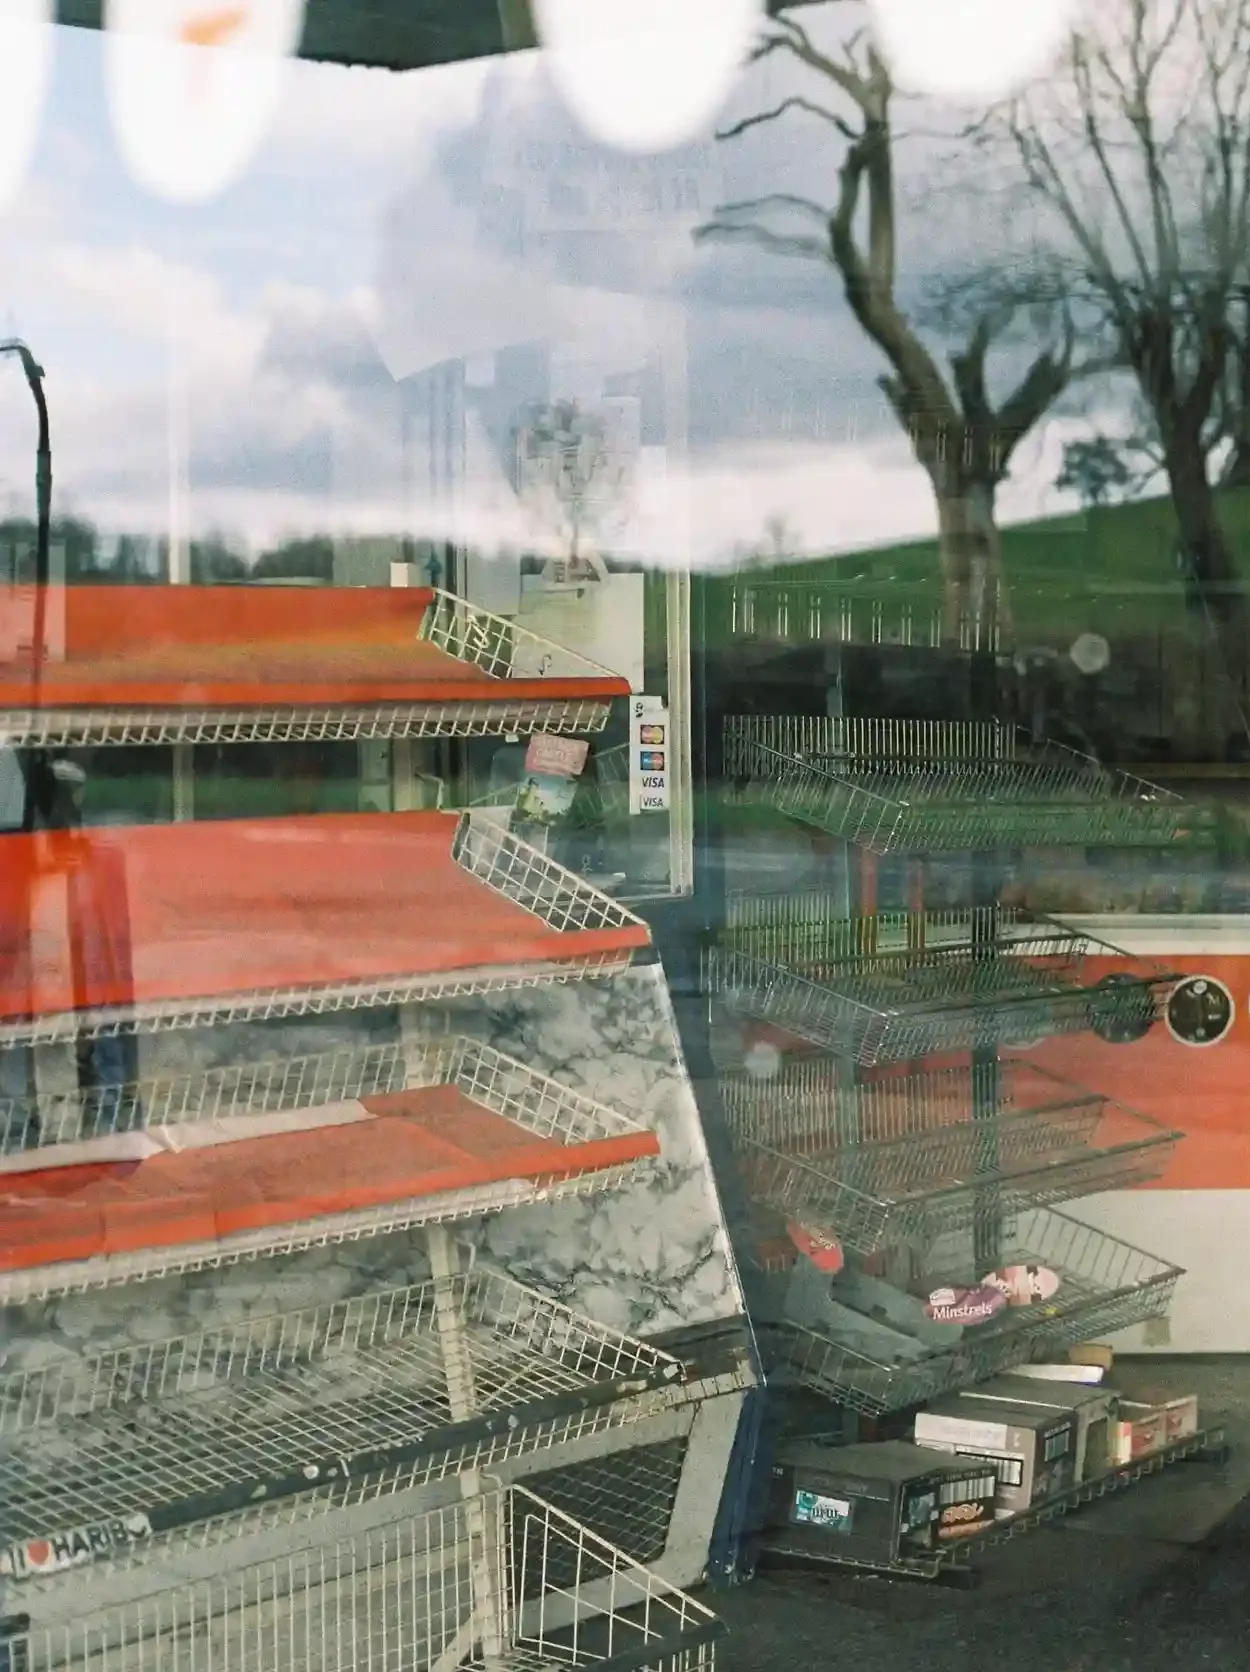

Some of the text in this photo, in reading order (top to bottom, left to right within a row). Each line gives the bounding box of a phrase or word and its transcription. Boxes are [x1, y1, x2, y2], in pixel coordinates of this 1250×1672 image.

[642, 777, 665, 788] VISA
[643, 797, 664, 807] VISA
[932, 1302, 993, 1320] Minstrels
